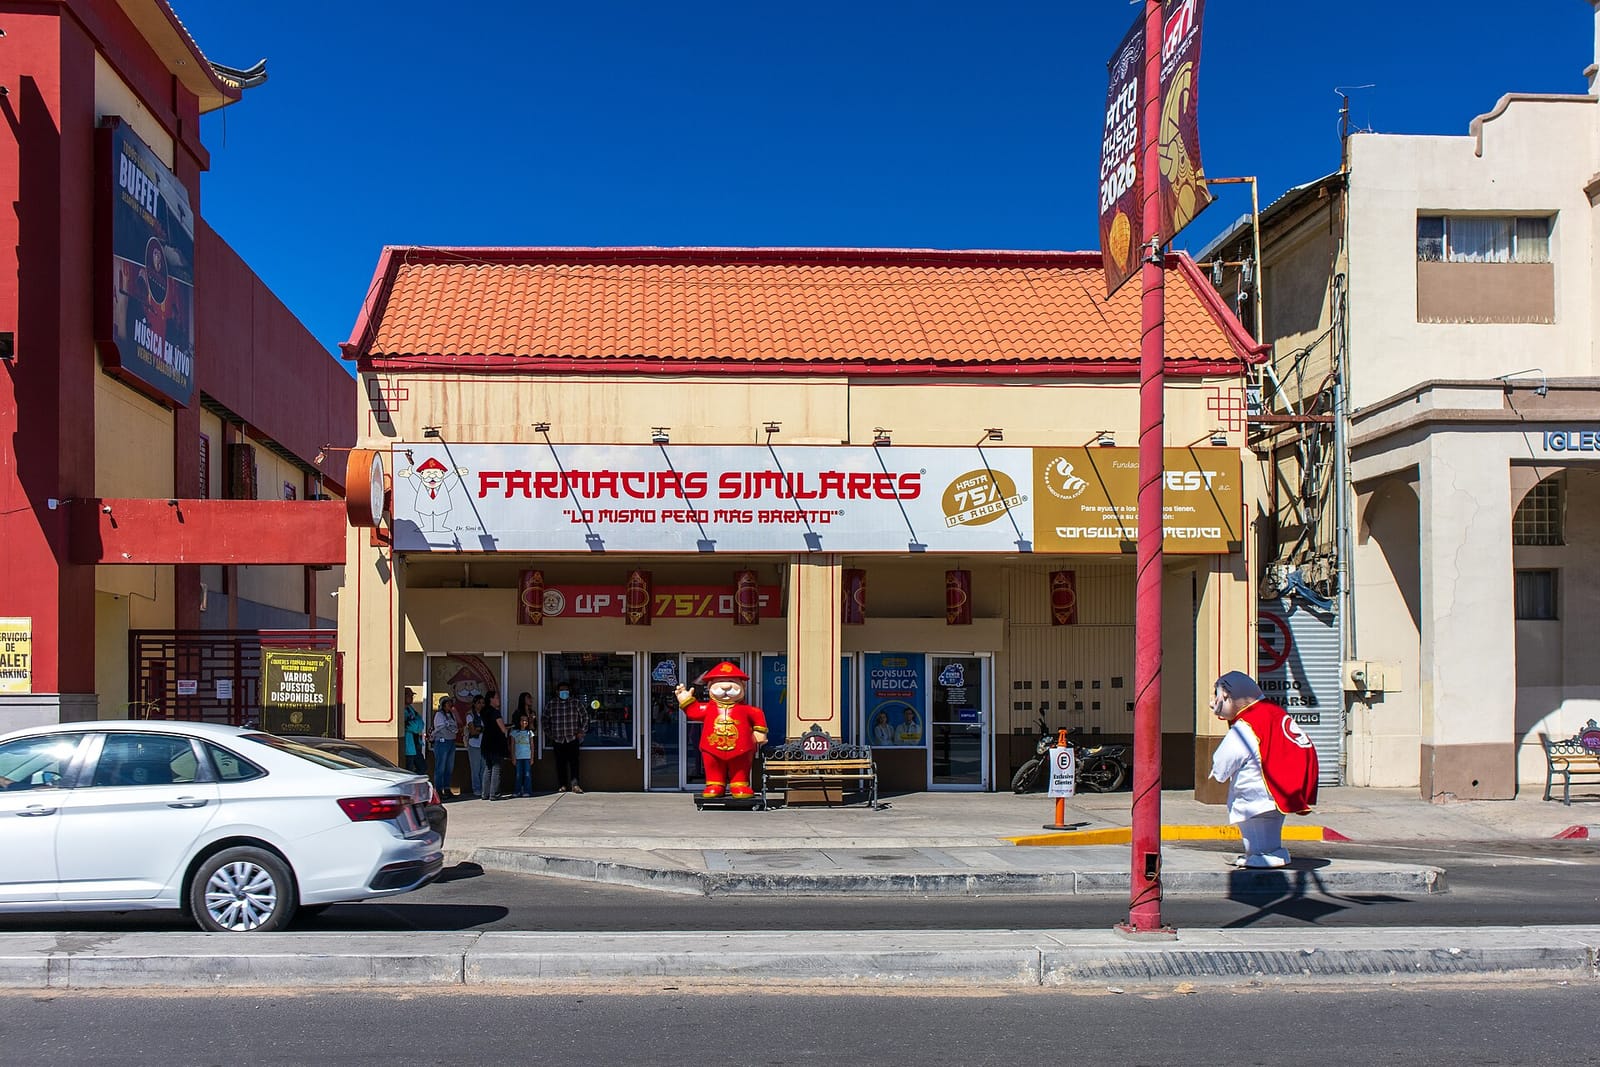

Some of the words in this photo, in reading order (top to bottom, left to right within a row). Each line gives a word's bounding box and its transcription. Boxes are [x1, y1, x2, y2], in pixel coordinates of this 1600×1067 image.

[1103, 108, 1137, 158] NUEVO
[1101, 127, 1138, 180] CHINO
[119, 152, 160, 219] BUFFET
[1101, 152, 1137, 215] 2026
[134, 317, 163, 358] MÚSICA
[164, 340, 174, 366] EN
[174, 346, 190, 377] VIVO
[1543, 430, 1600, 451] IGLES
[1112, 460, 1139, 469] Fundac
[478, 470, 708, 499] FARMACIAS
[719, 470, 922, 499] SIMILARES
[956, 474, 988, 491] HASTA
[1163, 471, 1217, 491] EST
[953, 481, 1001, 511] 75%
[949, 513, 966, 525] DE
[970, 497, 1019, 518] AHORRO
[1081, 504, 1096, 512] Para
[1126, 504, 1136, 512] los
[599, 509, 656, 524] MISMO
[661, 509, 709, 524] PERO
[713, 509, 753, 524] MAS
[1055, 527, 1138, 538] CONSULTO
[575, 594, 610, 614] UP
[655, 594, 714, 616] 75%
[718, 594, 769, 614] OF
[6, 643, 15, 652] DE
[0, 654, 28, 667] ALET
[283, 672, 313, 682] VARIOS
[871, 669, 918, 678] CONSULTA
[280, 682, 315, 692] PUESTOS
[871, 677, 918, 689] MÉDICA
[271, 692, 324, 703] DISPONIBLES
[1292, 714, 1319, 722] VICIO
[803, 741, 829, 751] 2021
[1061, 756, 1067, 766] E
